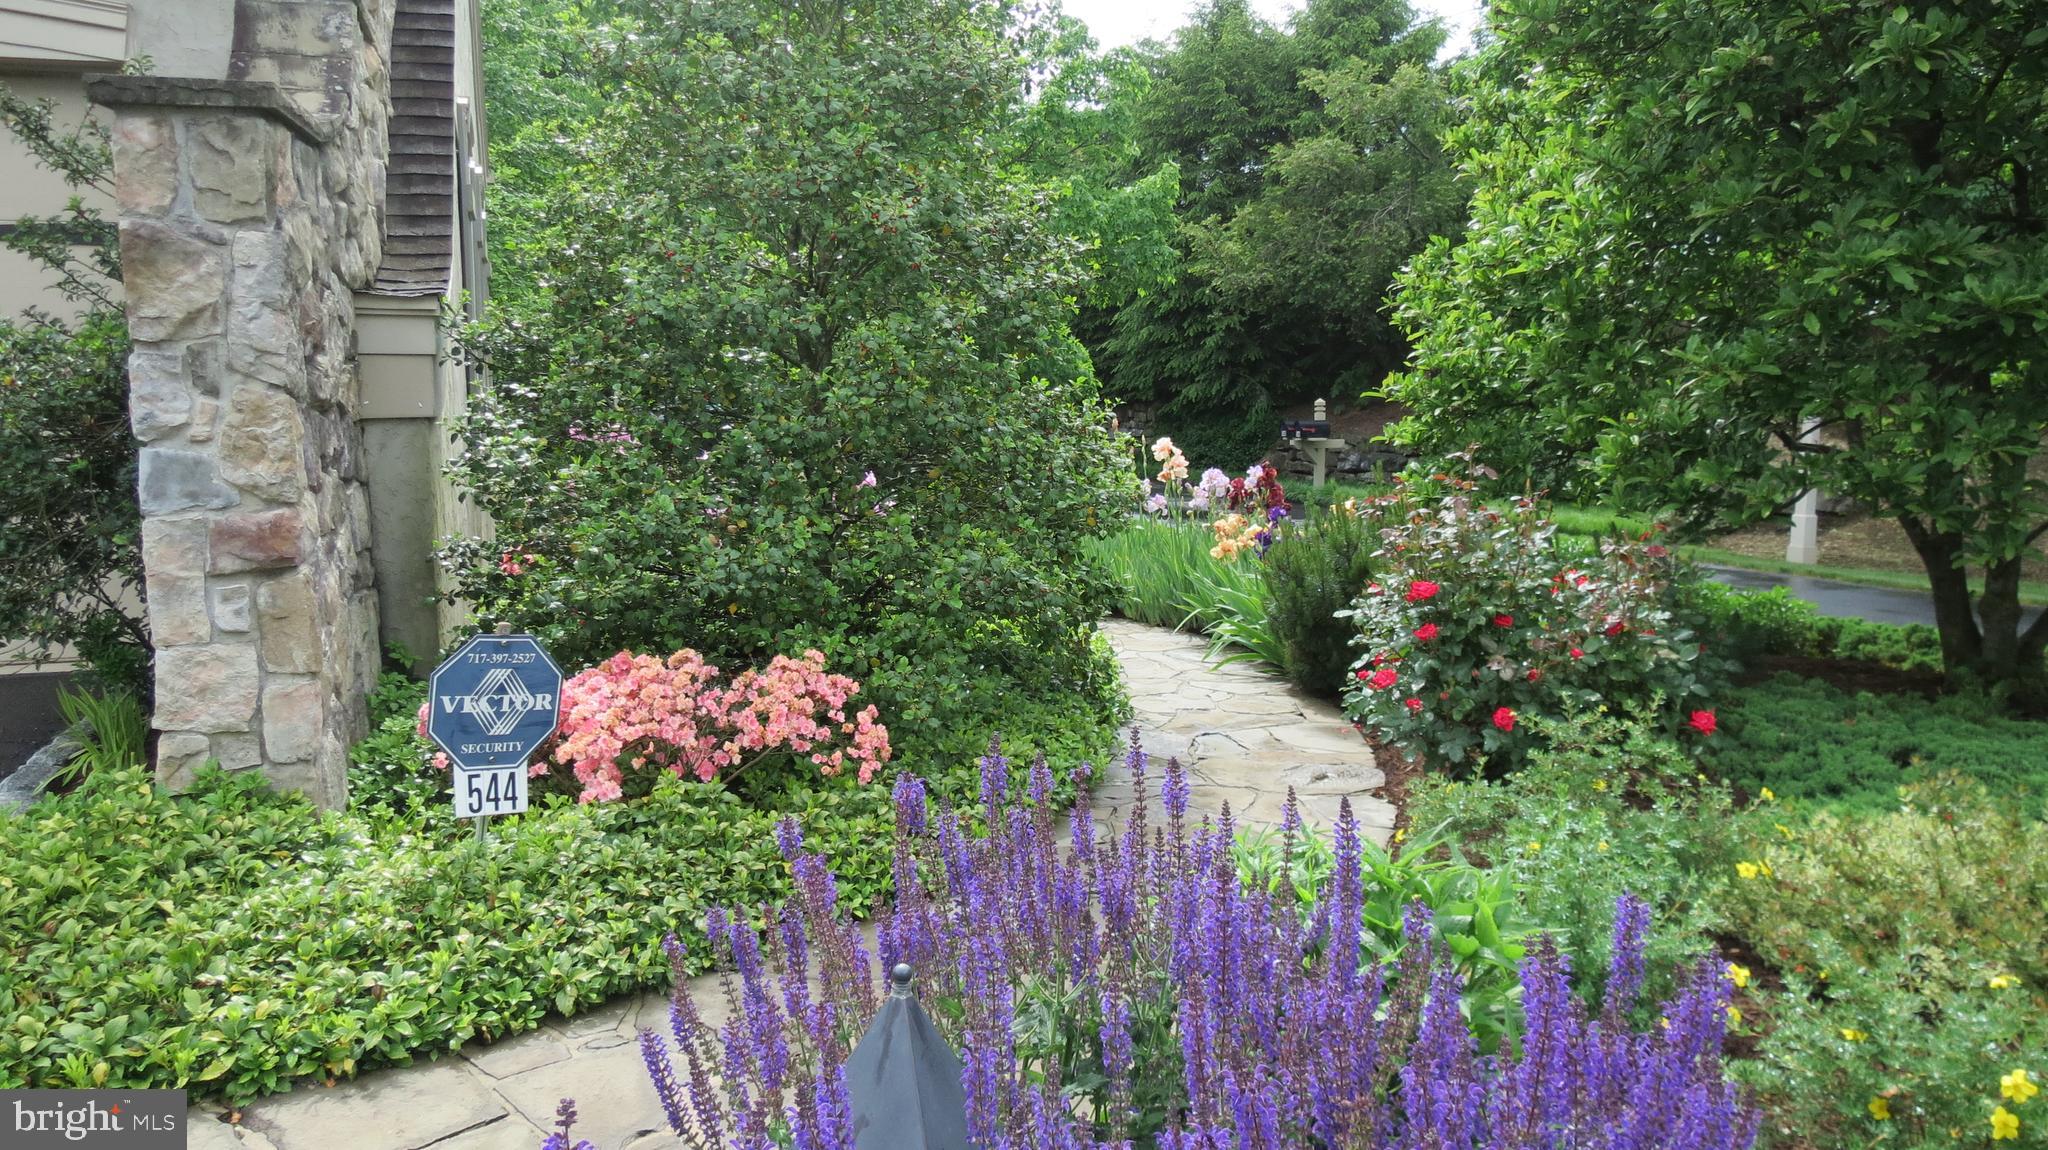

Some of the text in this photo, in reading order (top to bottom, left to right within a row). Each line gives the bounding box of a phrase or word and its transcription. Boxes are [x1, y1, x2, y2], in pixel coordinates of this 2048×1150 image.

[468, 653, 536, 664] 717-397-2527
[440, 693, 552, 714] VECTOR
[461, 741, 524, 754] SECURITY
[467, 771, 518, 814] 544
